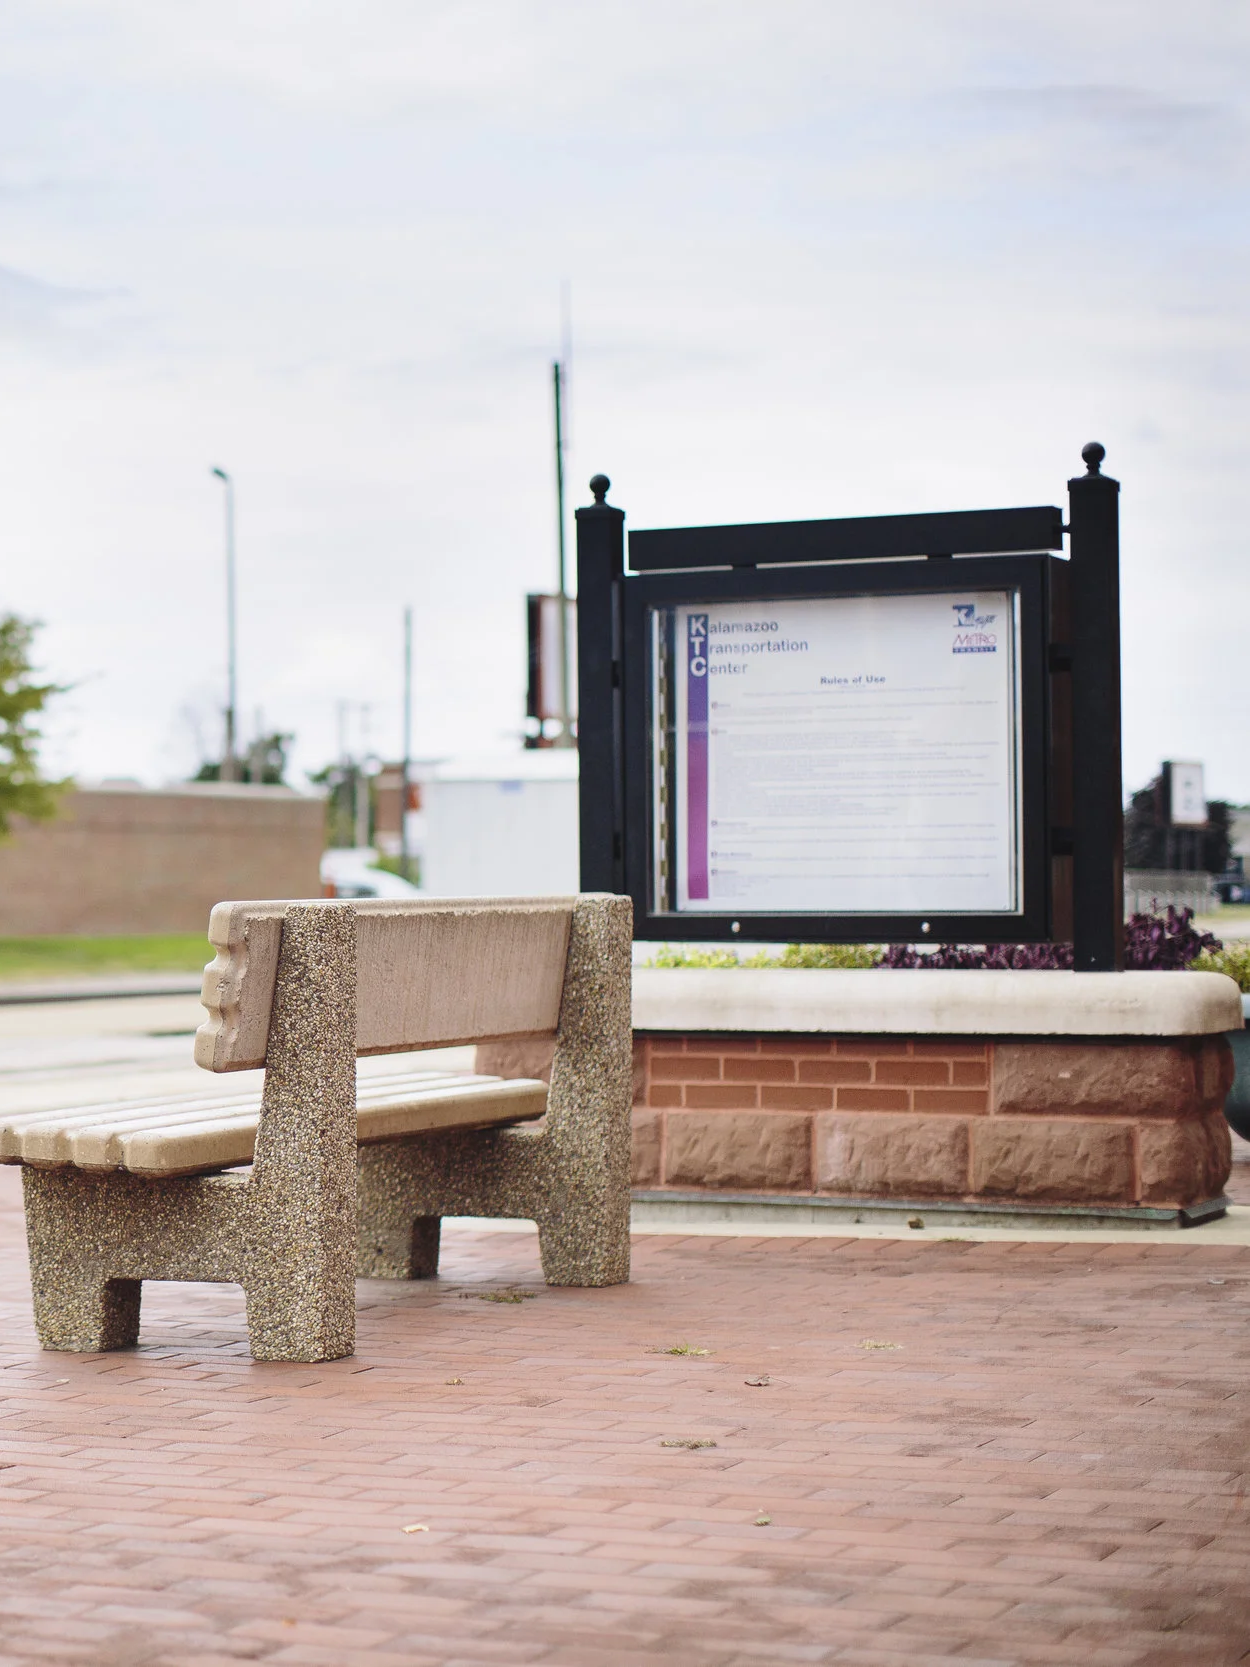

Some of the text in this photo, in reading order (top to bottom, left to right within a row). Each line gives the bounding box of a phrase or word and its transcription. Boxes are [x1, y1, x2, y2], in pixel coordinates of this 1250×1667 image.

[691, 616, 779, 636] Kalamazoo
[691, 636, 809, 656] Transportation
[691, 656, 747, 677] Center
[820, 676, 848, 684] Rules
[866, 675, 886, 683] Use
